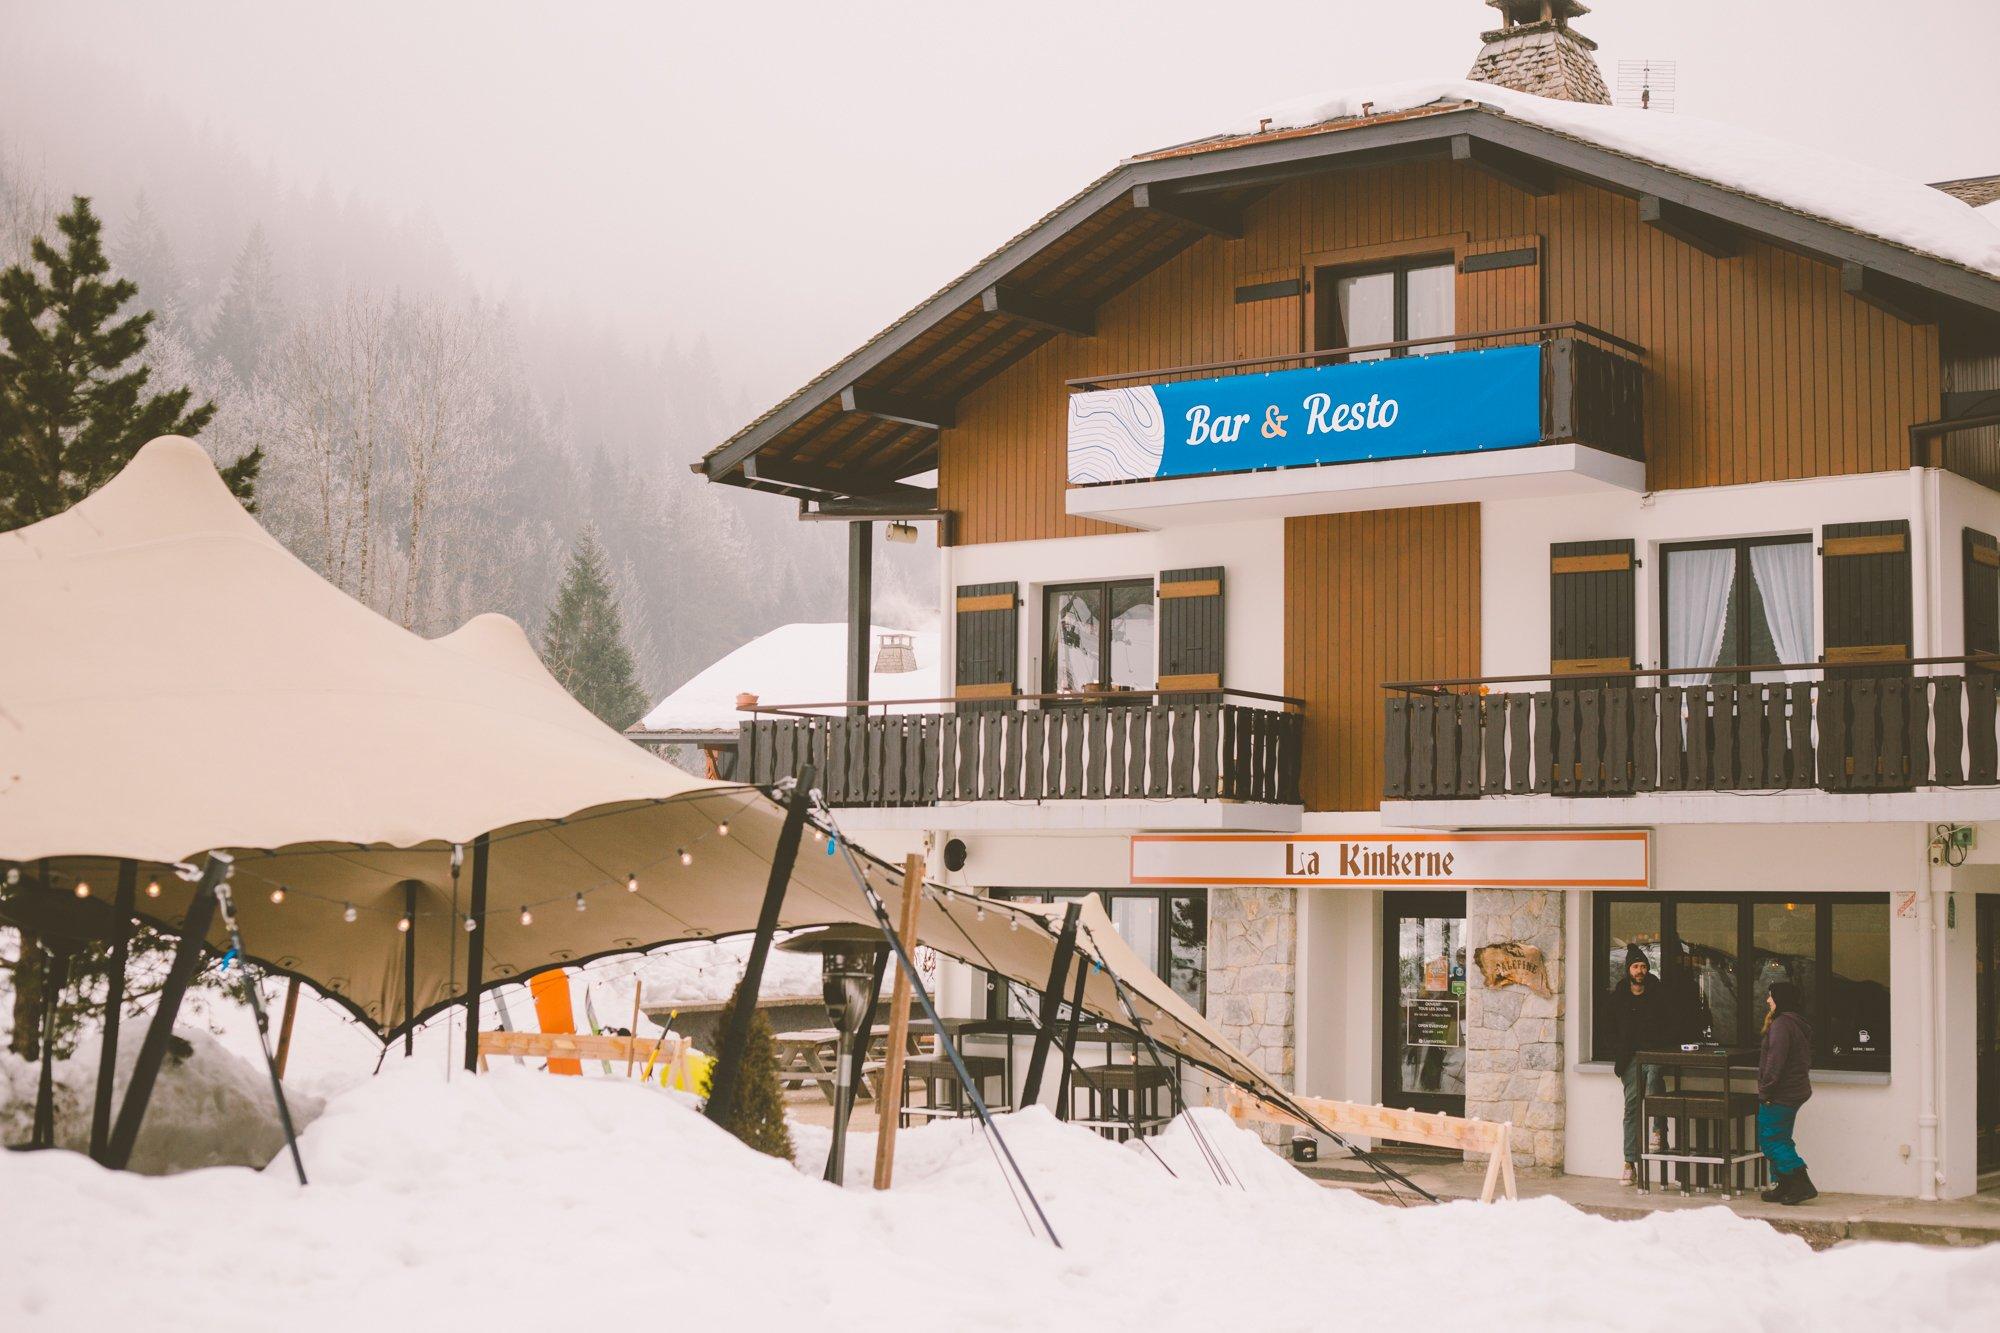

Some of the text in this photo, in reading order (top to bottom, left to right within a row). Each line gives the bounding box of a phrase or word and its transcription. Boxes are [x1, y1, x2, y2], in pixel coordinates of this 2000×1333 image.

[1185, 392, 1399, 446] Bar & Resto
[1285, 843, 1455, 877] La Kinkerne
